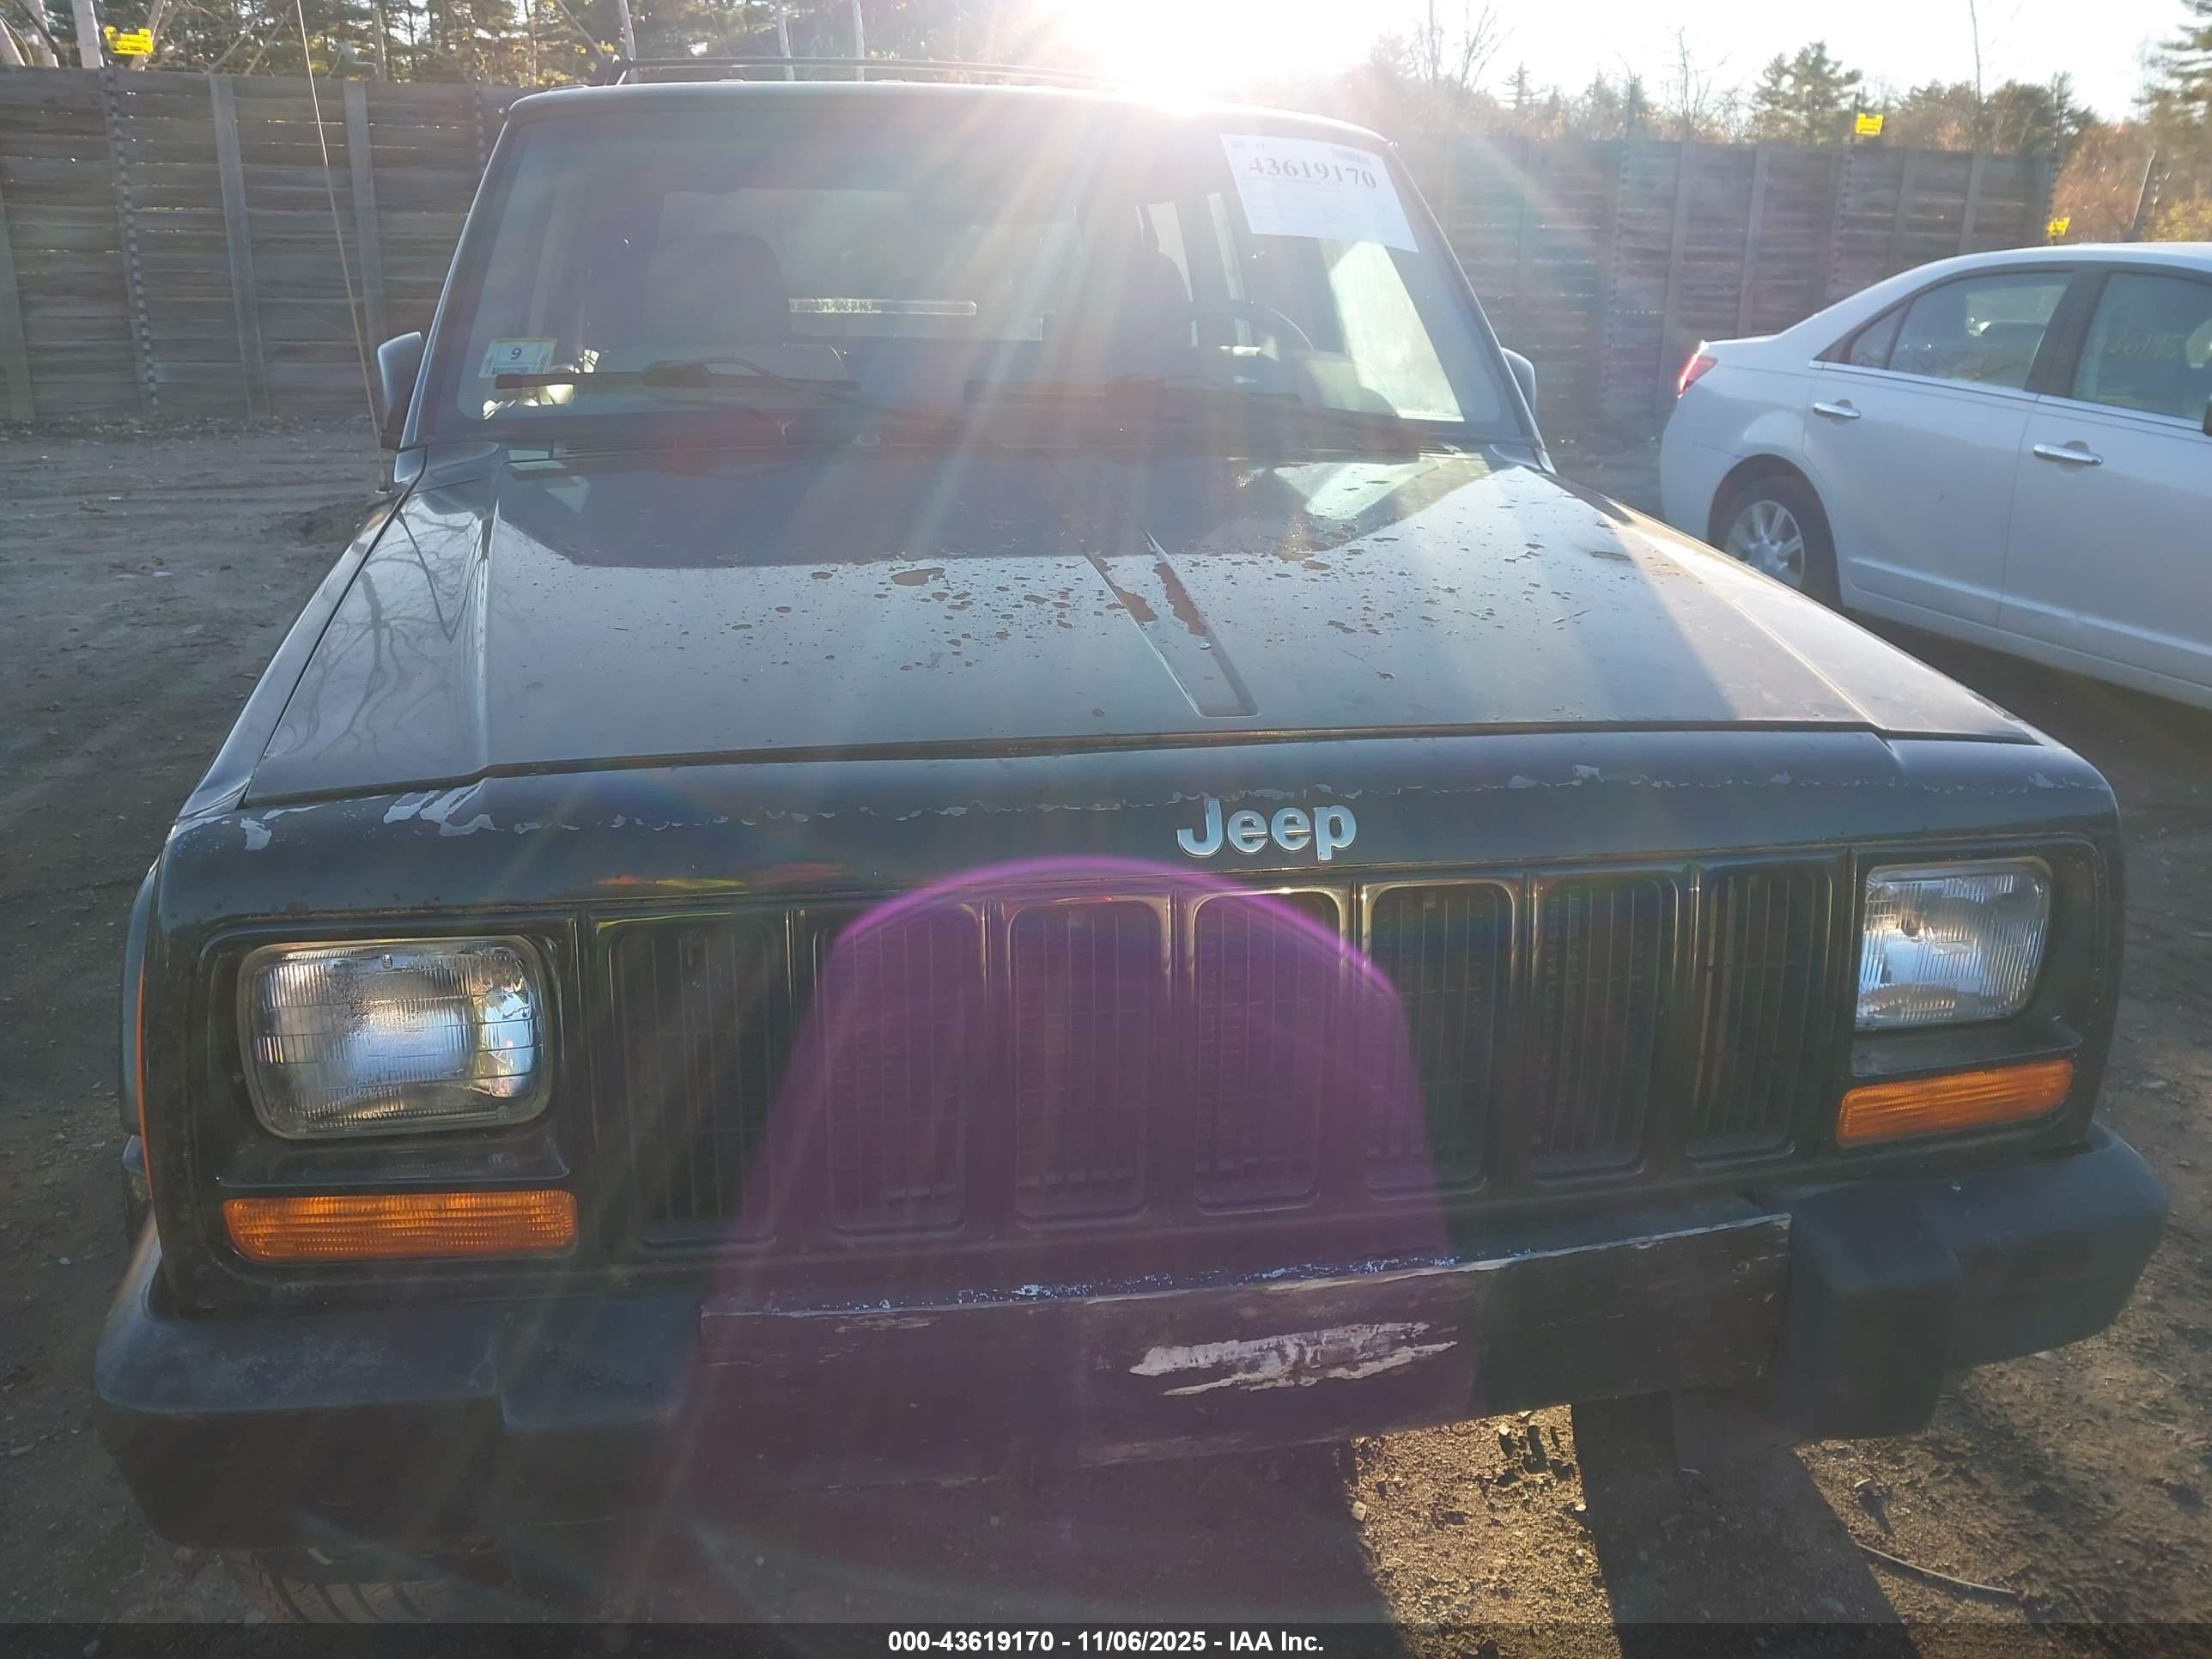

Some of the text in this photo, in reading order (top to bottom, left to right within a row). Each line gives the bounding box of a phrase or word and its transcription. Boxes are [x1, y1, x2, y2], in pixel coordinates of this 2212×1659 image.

[1249, 156, 1377, 190] 43619170
[510, 347, 523, 361] 9
[1176, 797, 1358, 862] Jeep
